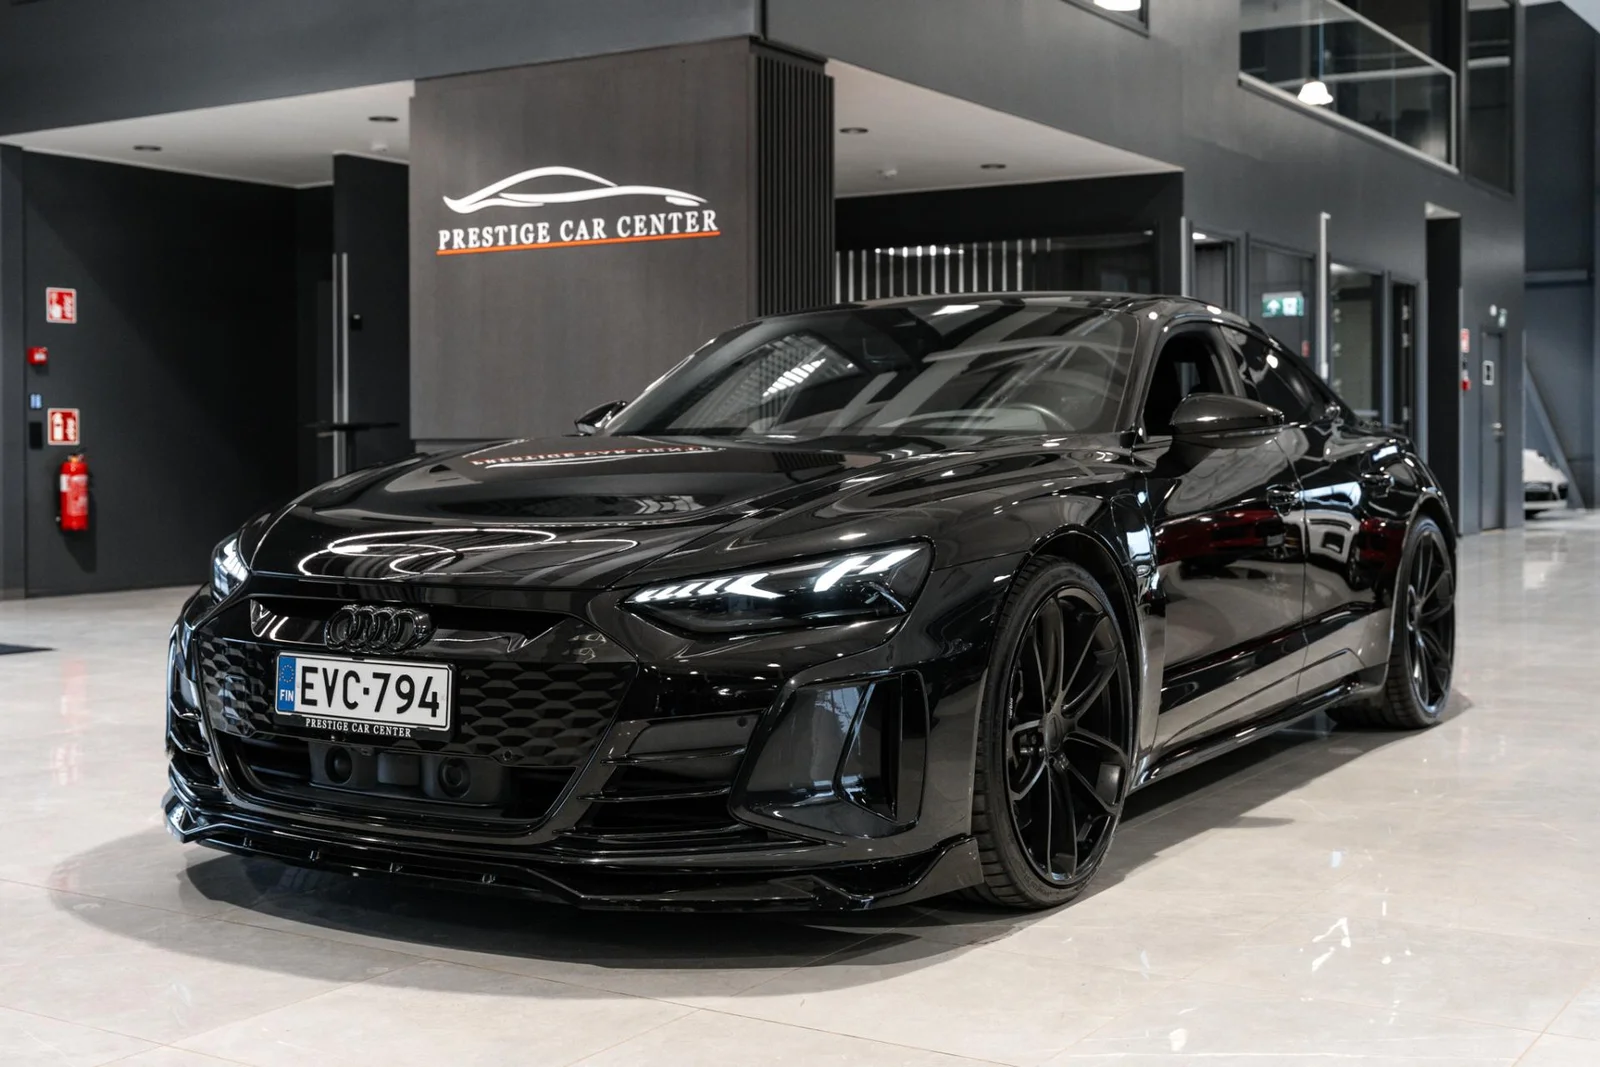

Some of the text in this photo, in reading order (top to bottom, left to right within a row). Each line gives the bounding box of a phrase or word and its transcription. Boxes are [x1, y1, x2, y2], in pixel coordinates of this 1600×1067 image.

[438, 210, 719, 250] PRESTIGE CAR CENTER
[279, 689, 294, 702] FIN
[305, 718, 411, 738] PRESTIGE CAR CENTER
